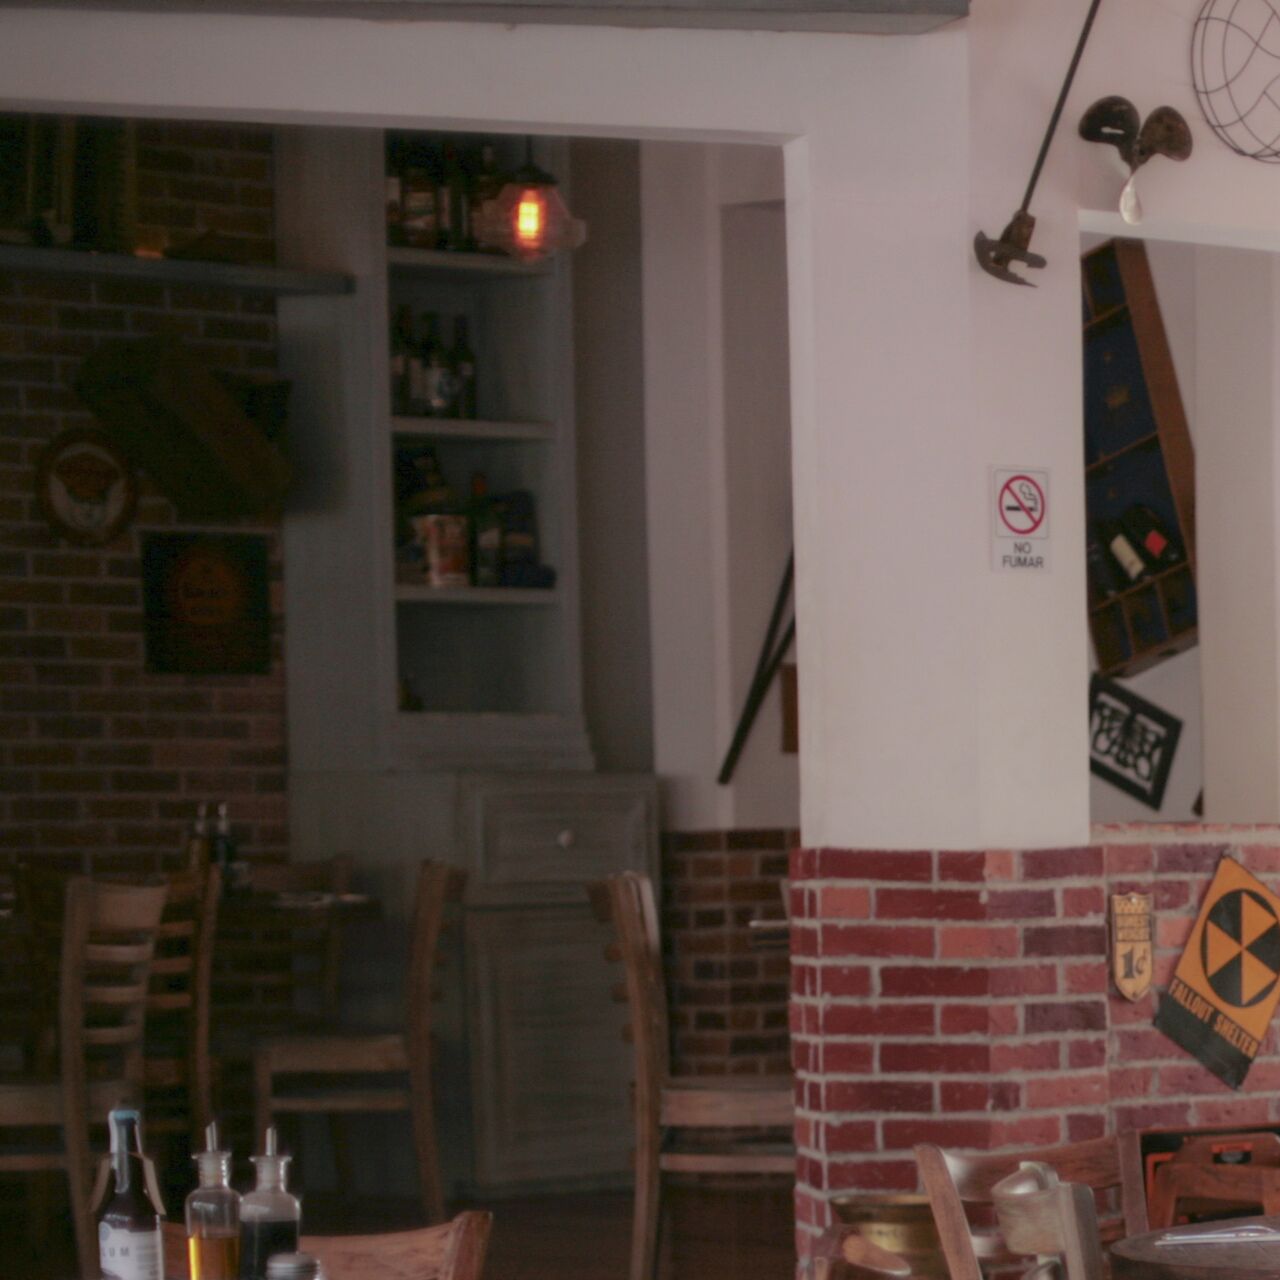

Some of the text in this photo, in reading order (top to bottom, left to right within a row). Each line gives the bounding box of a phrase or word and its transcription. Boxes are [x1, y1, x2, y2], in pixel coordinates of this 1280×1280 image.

[1013, 541, 1032, 554] NO
[1002, 554, 1045, 568] FUMAR
[1168, 978, 1260, 1059] FALLOUT SHELTER
